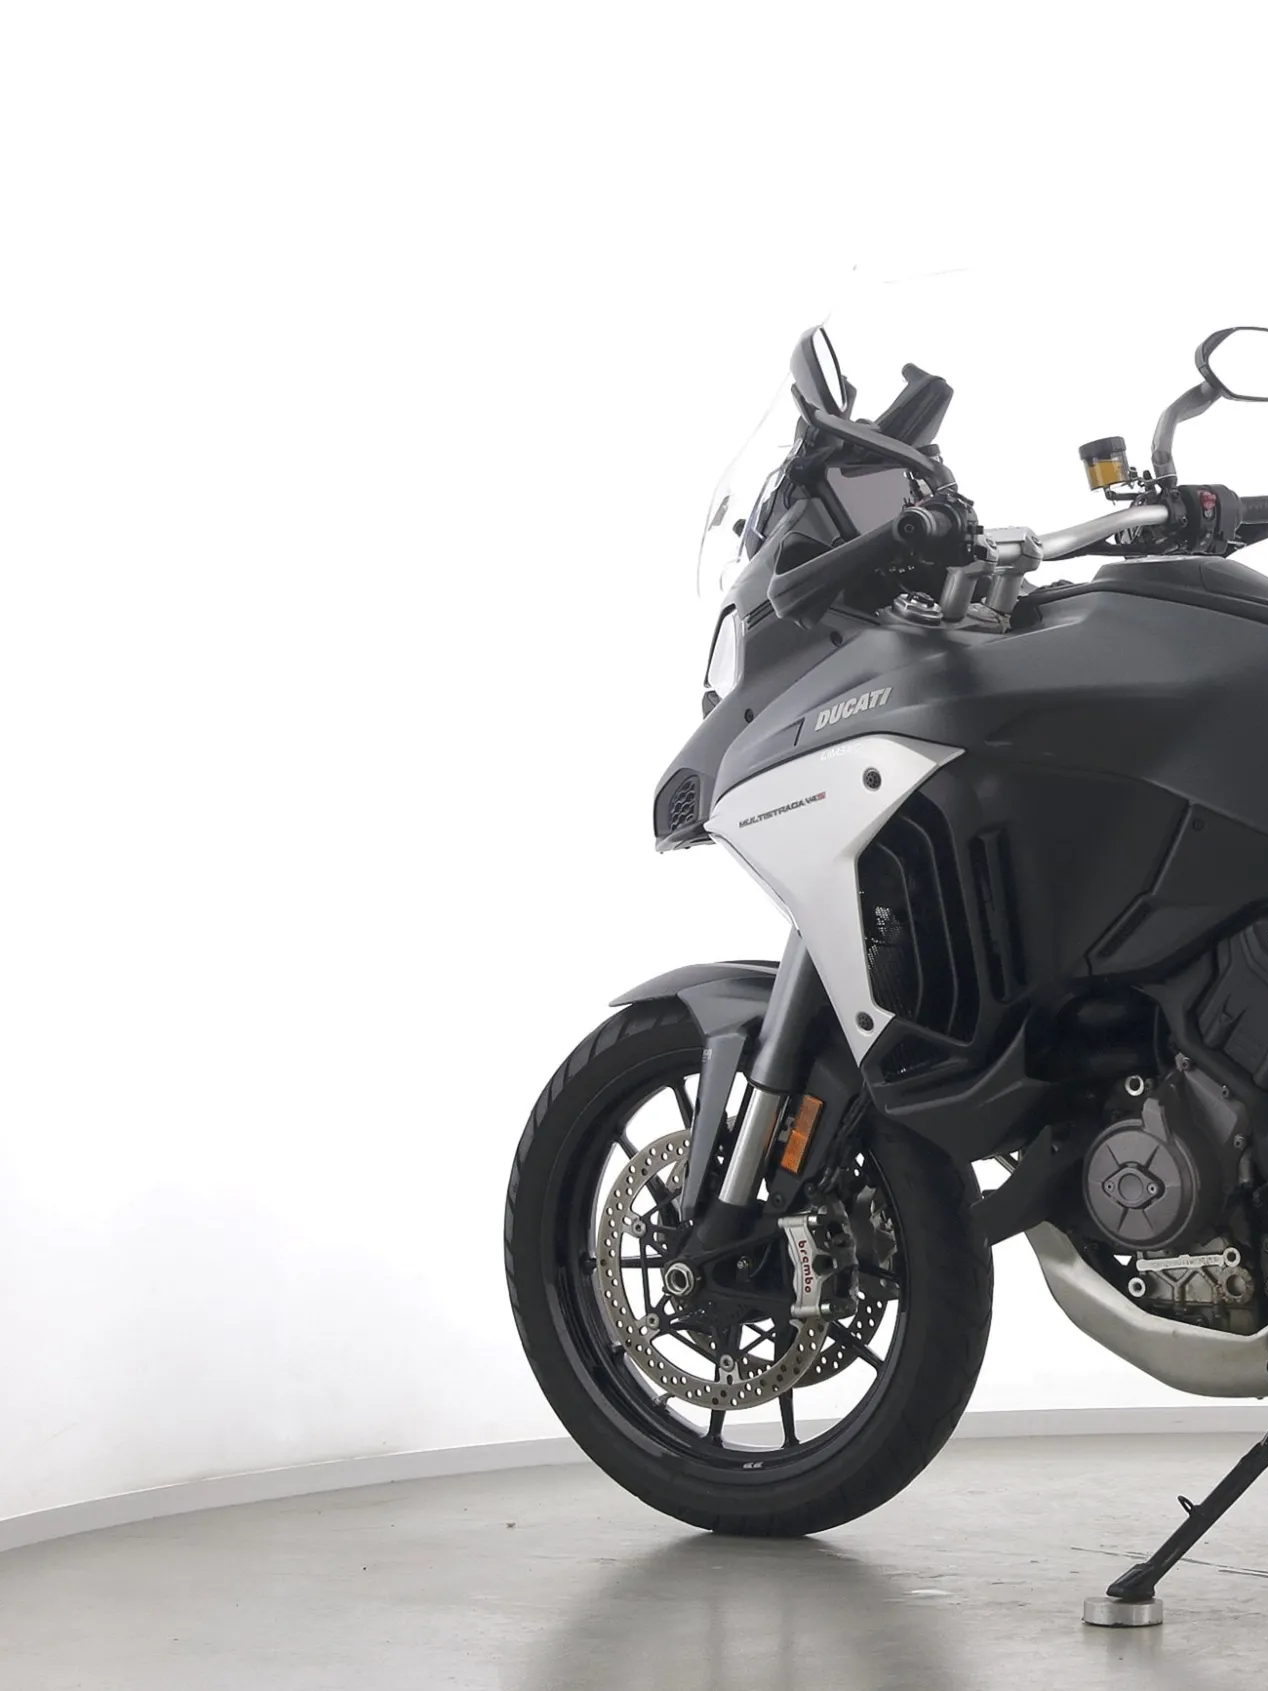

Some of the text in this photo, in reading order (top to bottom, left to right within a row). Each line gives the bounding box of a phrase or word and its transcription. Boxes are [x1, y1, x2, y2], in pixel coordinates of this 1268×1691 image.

[814, 687, 893, 732] DUCATI
[738, 799, 805, 828] MULTISTRADA
[798, 1240, 814, 1293] brembo
